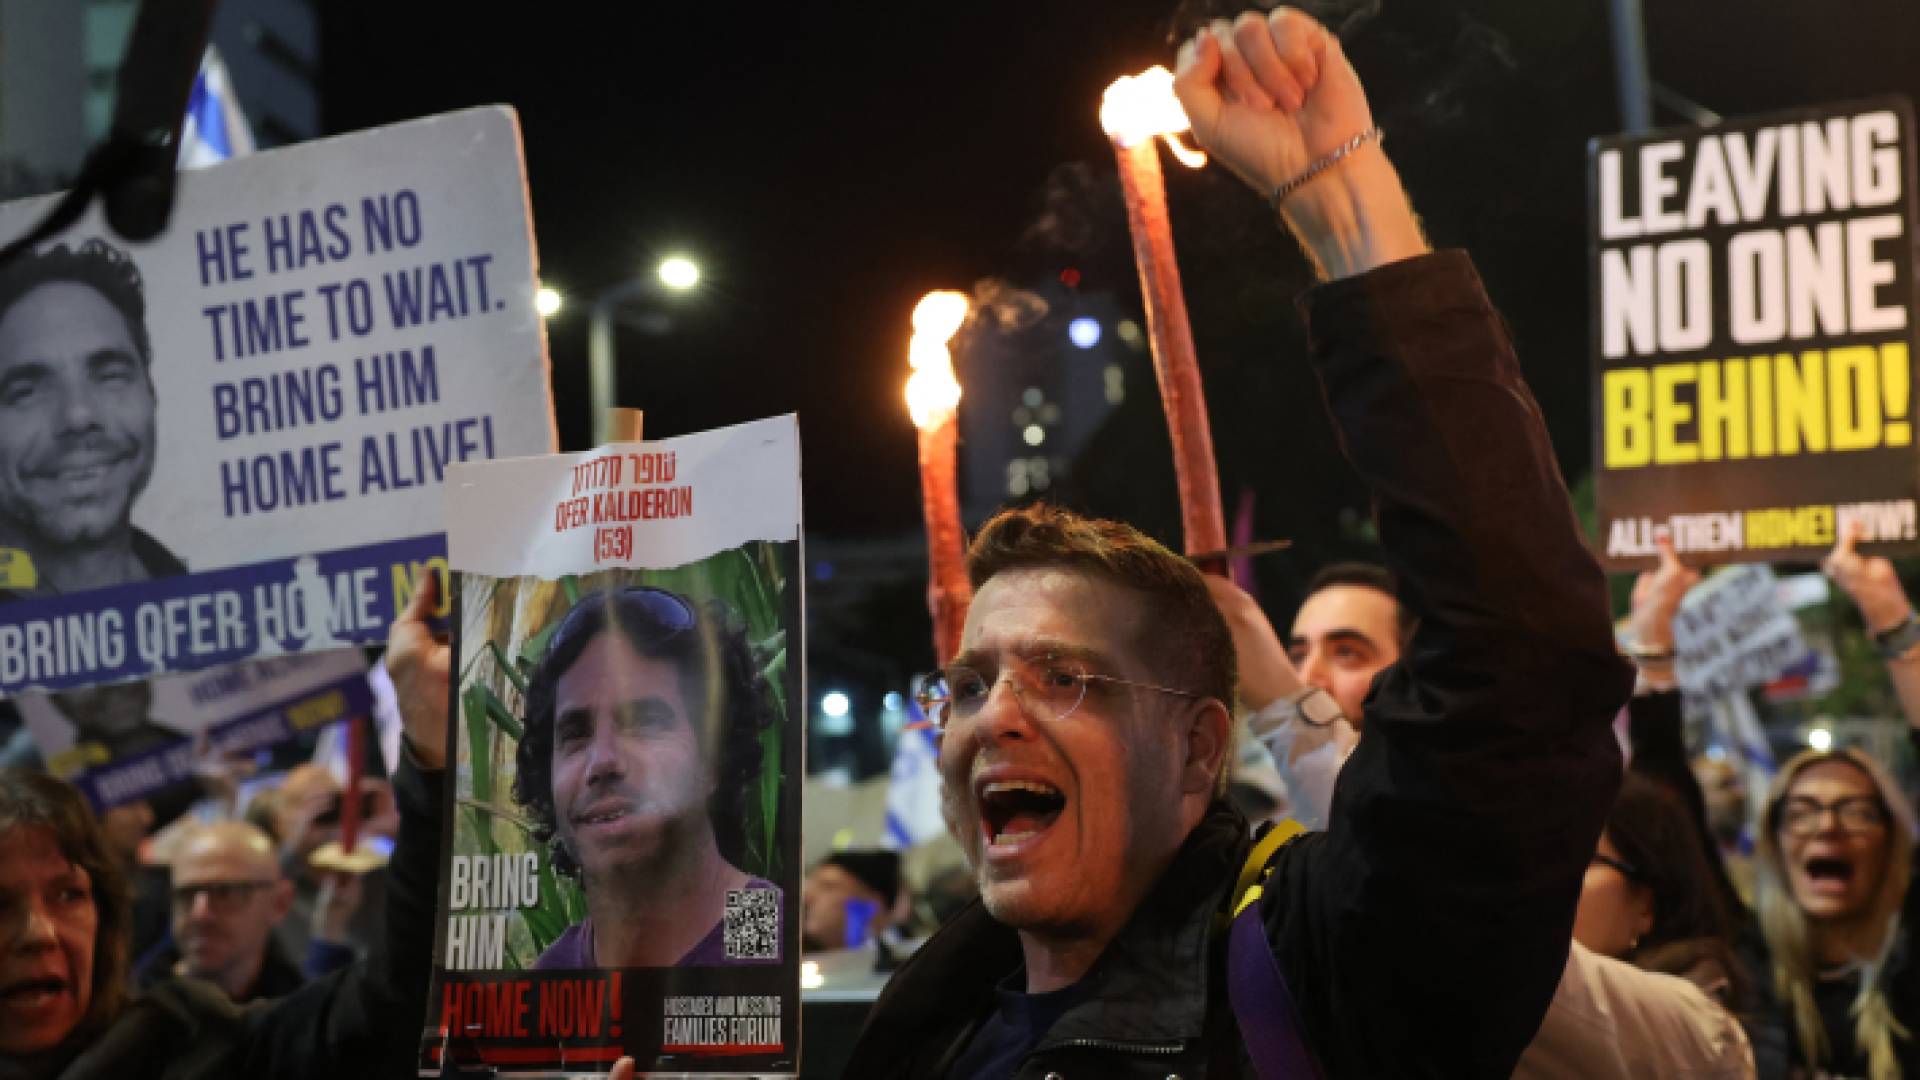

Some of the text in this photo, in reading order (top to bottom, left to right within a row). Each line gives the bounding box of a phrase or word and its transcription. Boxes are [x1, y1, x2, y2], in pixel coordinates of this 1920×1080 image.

[1600, 110, 1900, 241] LEAVING
[197, 189, 421, 287] HE HAS NO
[203, 254, 506, 362] TIME TO WAIT.
[1602, 216, 1906, 359] NO ONE
[213, 345, 440, 440] BRING HIM
[1603, 342, 1911, 470] BEHIND!
[221, 442, 347, 517] HOME
[628, 450, 676, 484] עופר
[555, 486, 692, 532] OFER KALDERON
[593, 524, 633, 566] (53)
[0, 609, 126, 686] BRING
[255, 567, 381, 646] HOME
[449, 852, 540, 910] BRING
[445, 915, 507, 970] HIM
[439, 971, 623, 1039] HOME NOW!
[664, 1017, 782, 1046] FAMILIES FORUM
